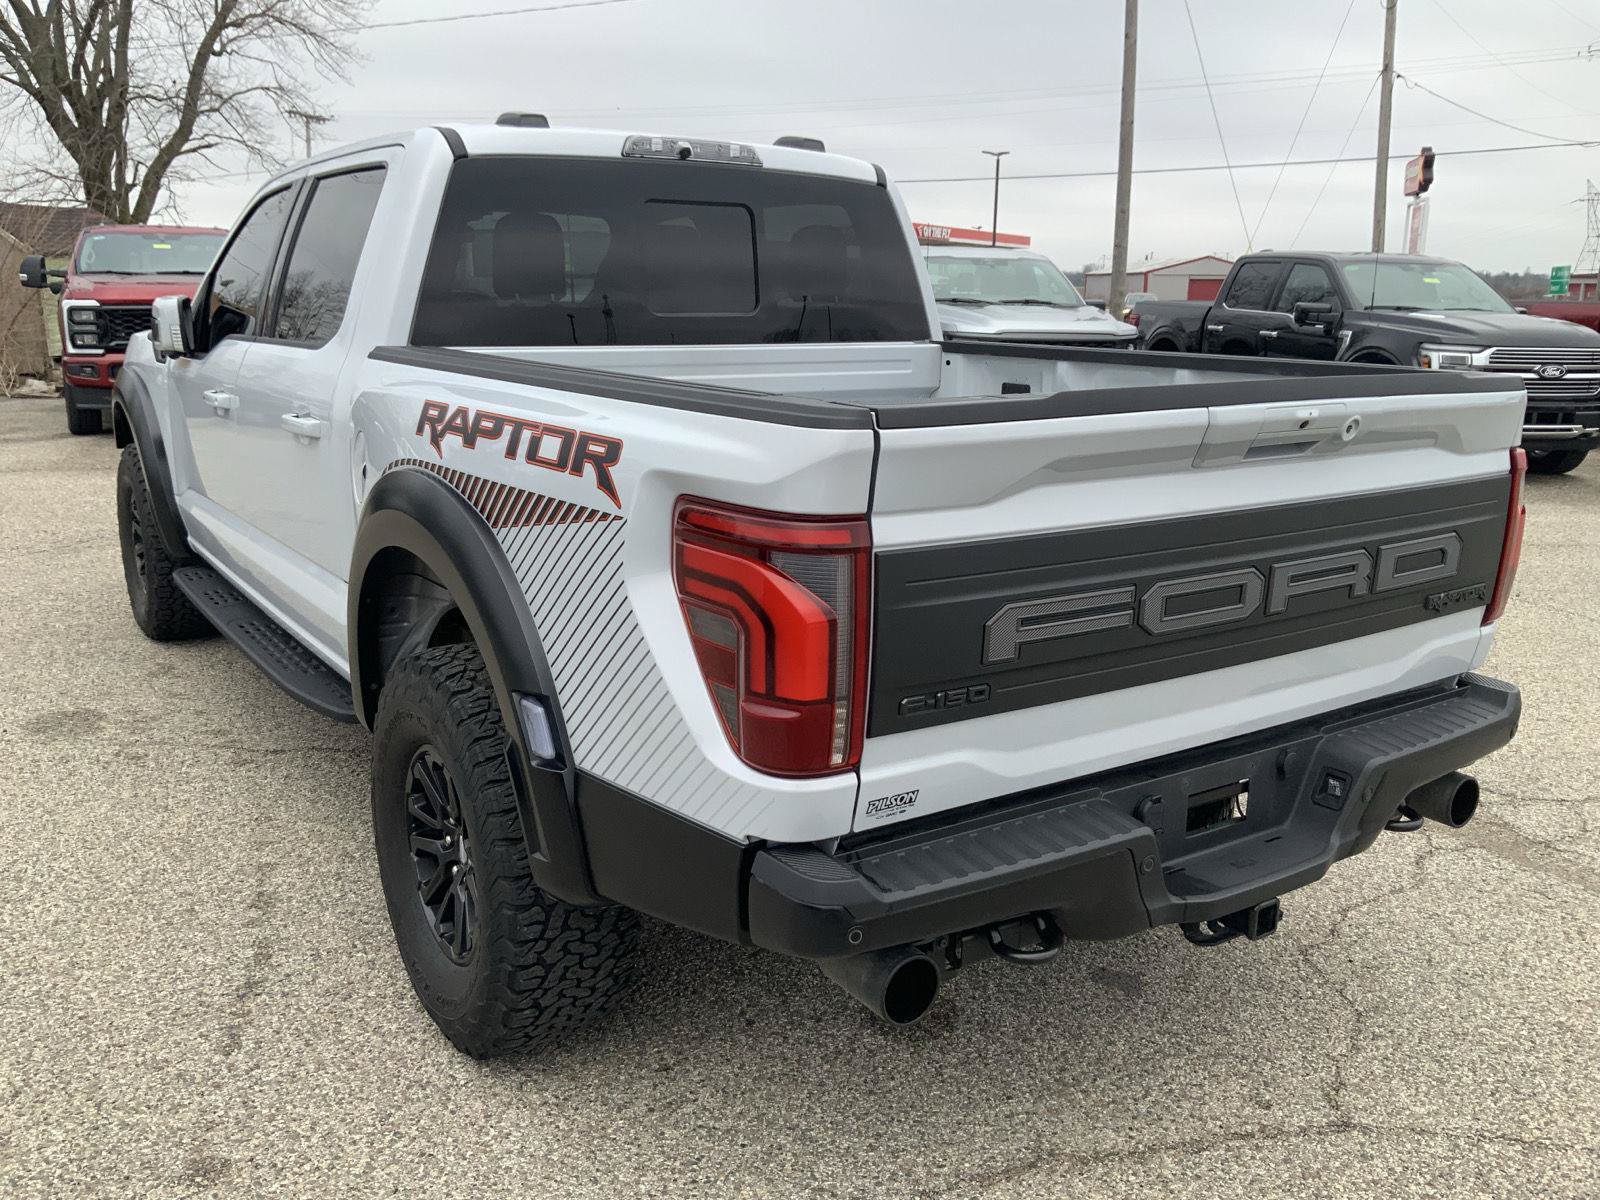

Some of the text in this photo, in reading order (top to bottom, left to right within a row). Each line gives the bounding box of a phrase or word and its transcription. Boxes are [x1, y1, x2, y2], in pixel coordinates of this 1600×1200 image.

[416, 399, 623, 509] RAPTOR
[982, 531, 1463, 666] FORD
[899, 683, 991, 716] F-150
[865, 789, 919, 814] PILSON
